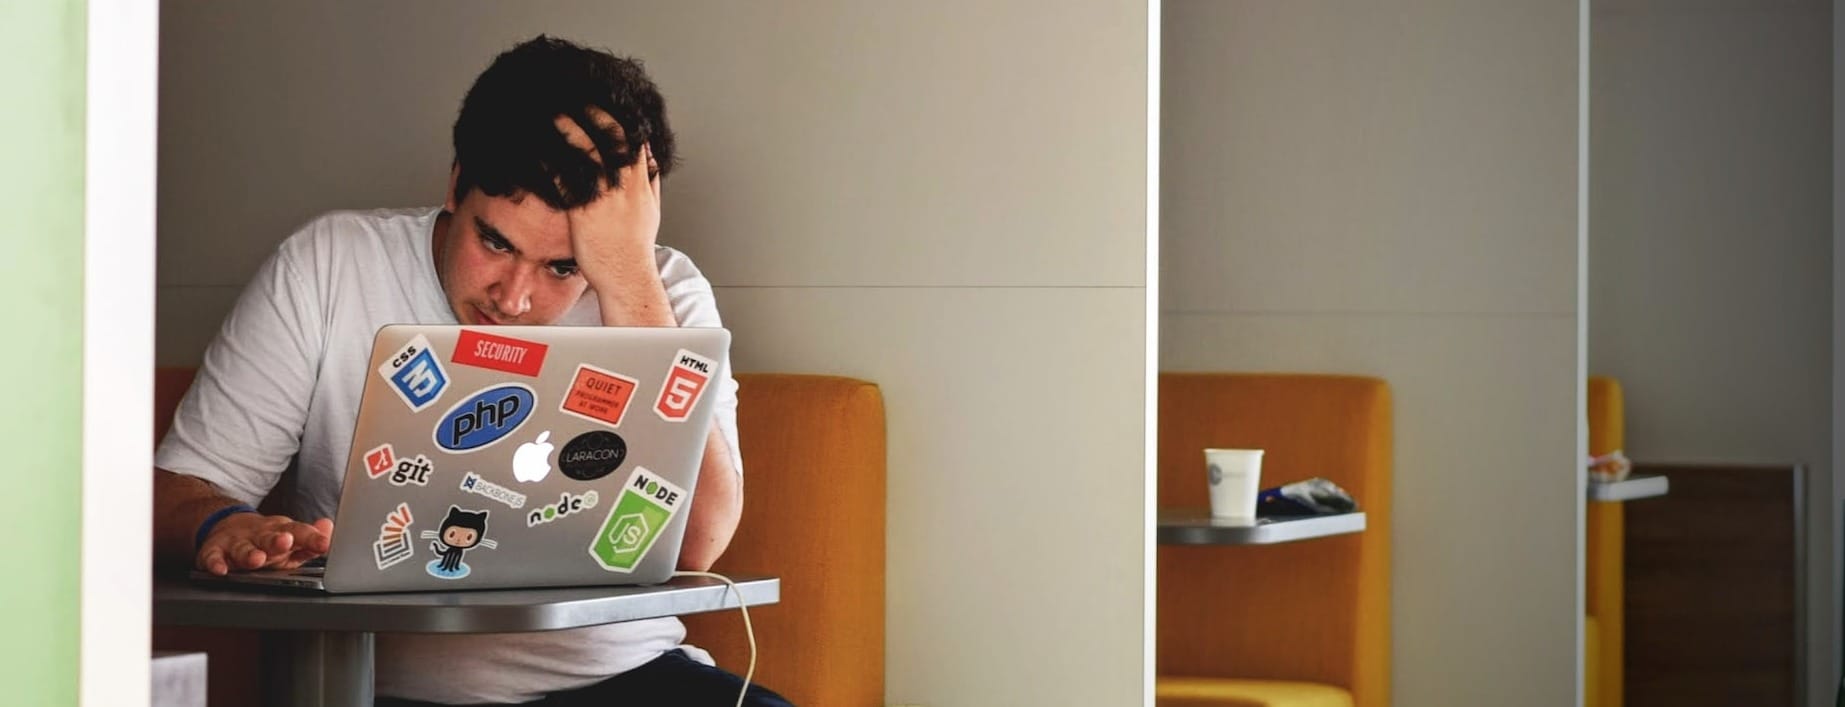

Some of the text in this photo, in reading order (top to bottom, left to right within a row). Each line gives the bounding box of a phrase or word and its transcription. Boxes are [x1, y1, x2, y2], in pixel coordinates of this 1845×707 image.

[392, 345, 417, 369] CSS
[474, 339, 529, 365] SECURITY
[680, 355, 709, 374] HTML
[586, 377, 622, 396] QUIET
[665, 376, 698, 410] 5
[452, 395, 520, 446] php
[566, 448, 619, 463] LARACON
[392, 458, 430, 484] git
[634, 474, 678, 506] NODE
